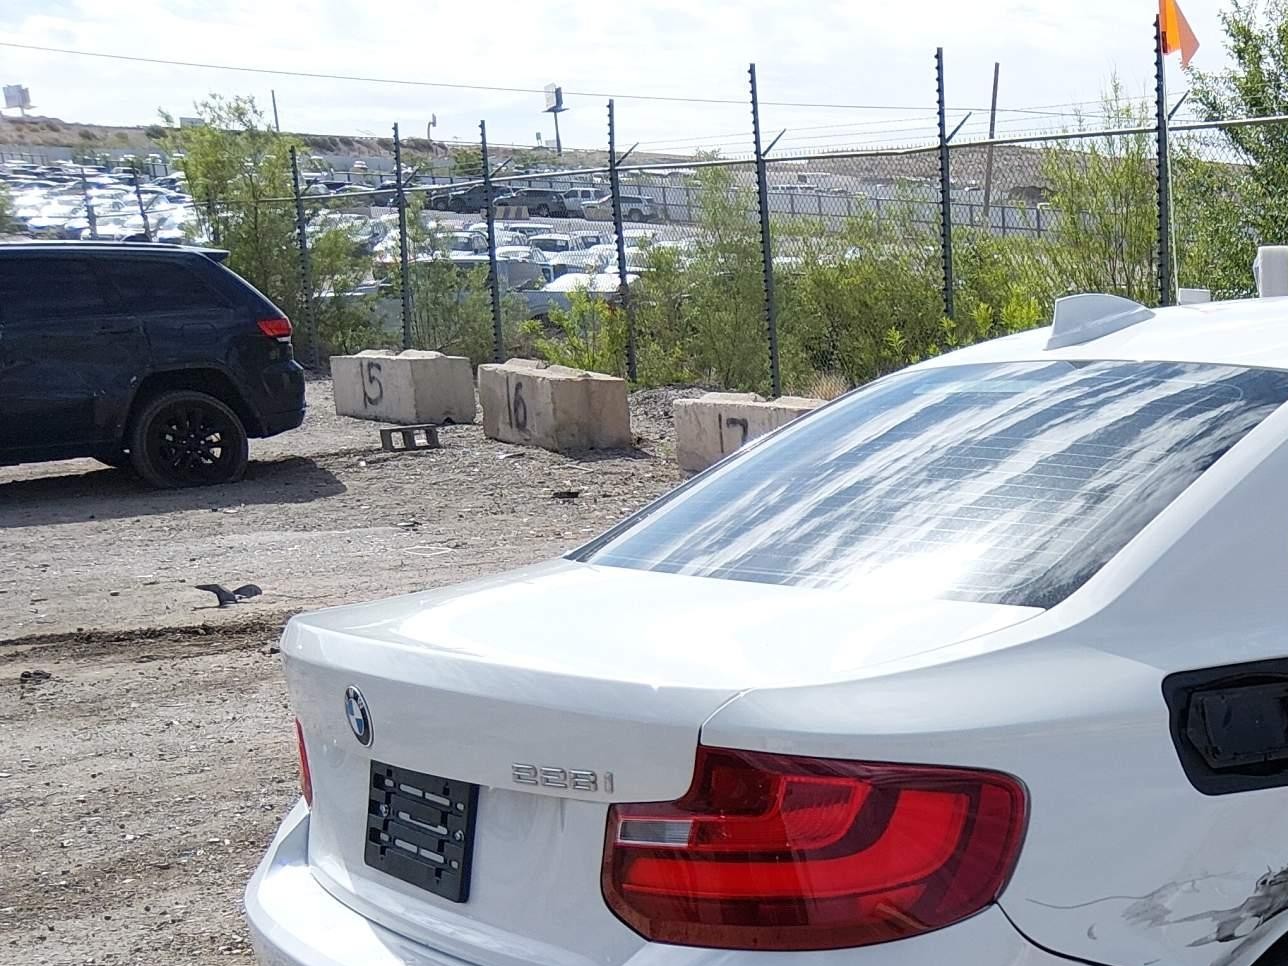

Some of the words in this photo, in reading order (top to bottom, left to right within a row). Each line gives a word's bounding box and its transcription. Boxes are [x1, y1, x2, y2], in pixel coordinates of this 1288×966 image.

[360, 360, 384, 408] 15
[506, 375, 528, 432] 16
[717, 412, 749, 454] 17
